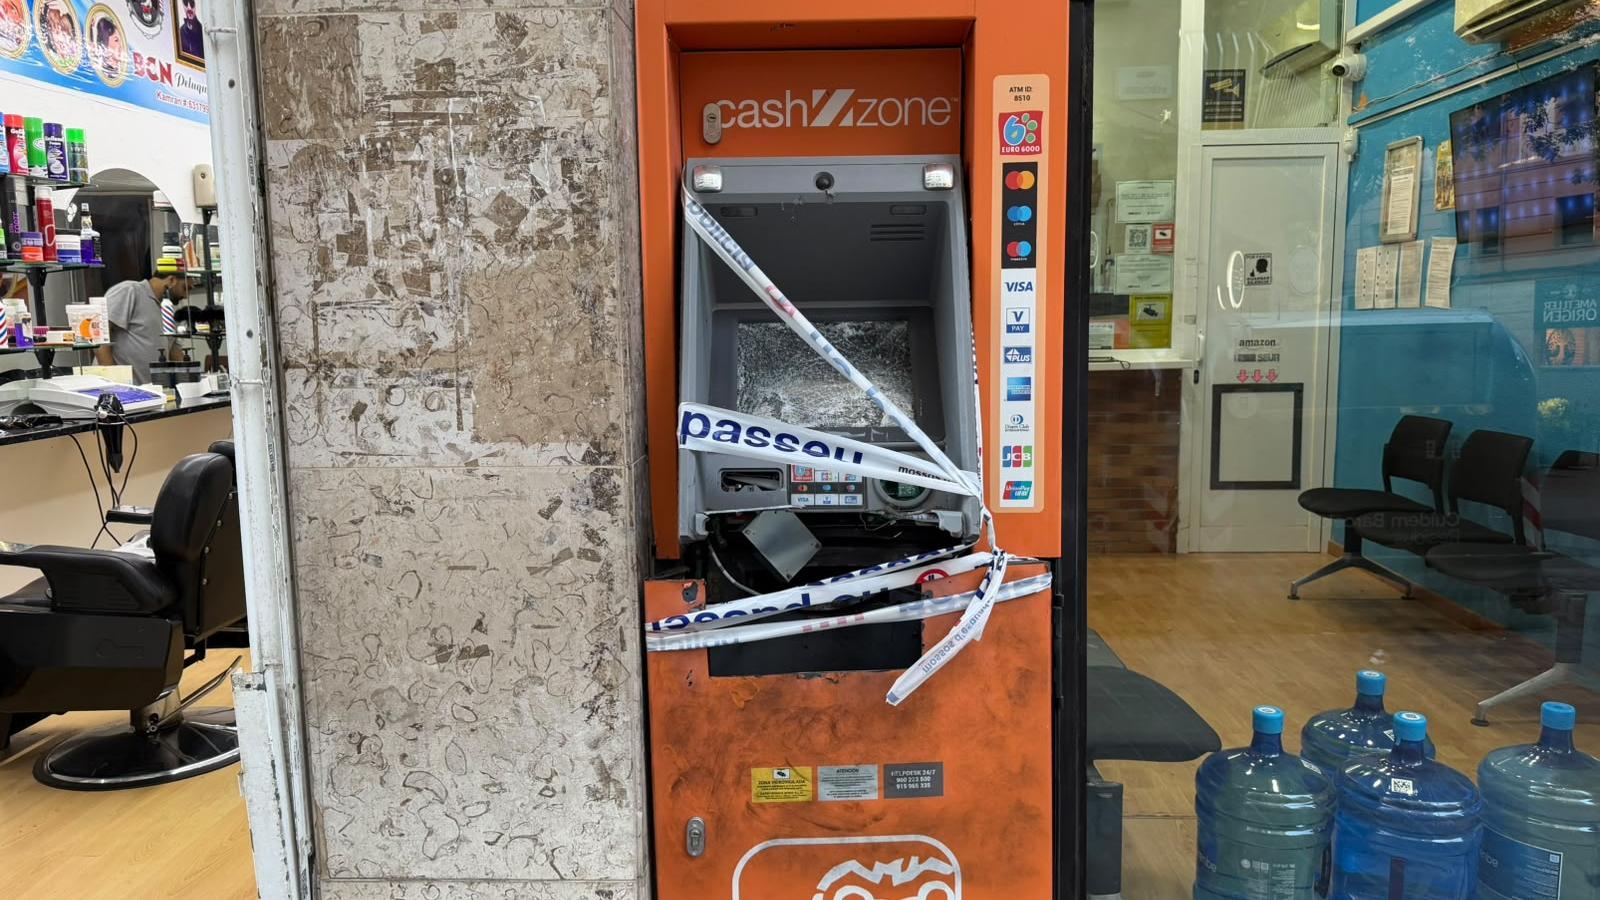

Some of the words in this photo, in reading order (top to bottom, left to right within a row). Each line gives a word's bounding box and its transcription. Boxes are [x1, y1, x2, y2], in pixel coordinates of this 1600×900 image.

[133, 52, 173, 87] BCN
[1005, 281, 1033, 292] VISA
[1013, 311, 1024, 322] V
[1239, 338, 1277, 347] amazon
[1012, 354, 1030, 362] PLUS
[1002, 453, 1031, 461] JCB
